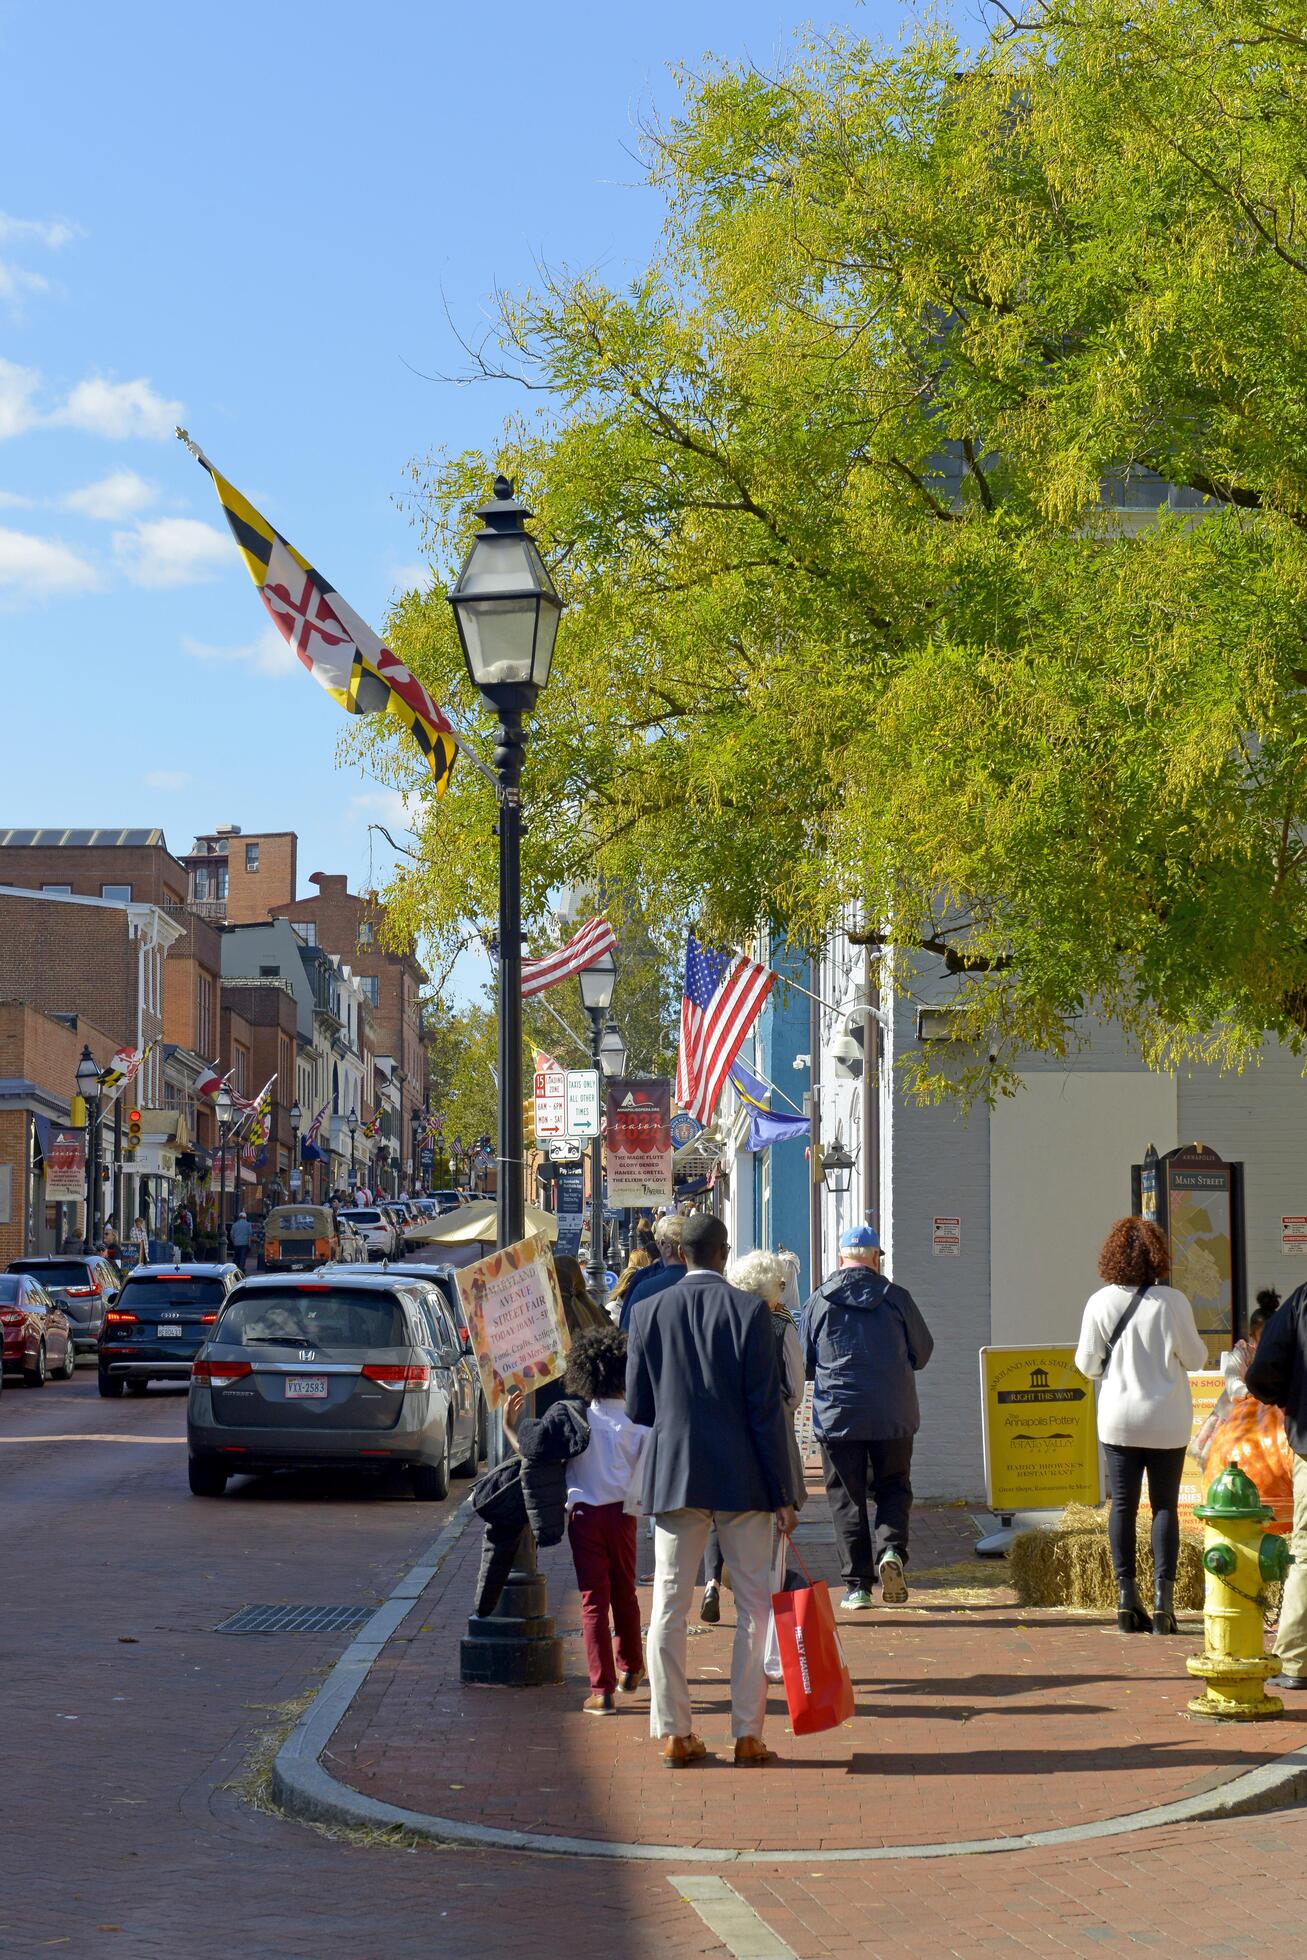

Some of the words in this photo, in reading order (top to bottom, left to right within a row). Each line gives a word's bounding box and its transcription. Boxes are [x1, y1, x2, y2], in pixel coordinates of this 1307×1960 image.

[537, 1076, 544, 1087] 15
[583, 1080, 595, 1088] ONLY
[580, 1094, 595, 1102] OTHER
[554, 1115, 562, 1123] SAT
[1175, 1175, 1196, 1184] MAIN
[1197, 1175, 1225, 1185] STREET
[487, 1268, 537, 1295] MARYLAND
[500, 1285, 533, 1307] AVENUE
[493, 1306, 525, 1328] STREET
[526, 1295, 546, 1312] FAIR
[491, 1326, 516, 1344] TODAY
[502, 1361, 518, 1373] Over
[991, 1363, 1023, 1391] MARYLAND
[1009, 1392, 1035, 1401] RIGHT
[1038, 1391, 1053, 1401] THIS
[1004, 1417, 1047, 1427] Annapolis
[1049, 1415, 1080, 1425] Pottery
[1007, 1463, 1037, 1471] HARRY
[1017, 1470, 1074, 1478] RESTAURANT
[795, 1626, 806, 1655] HELLY
[799, 1656, 812, 1694] HANSEN
